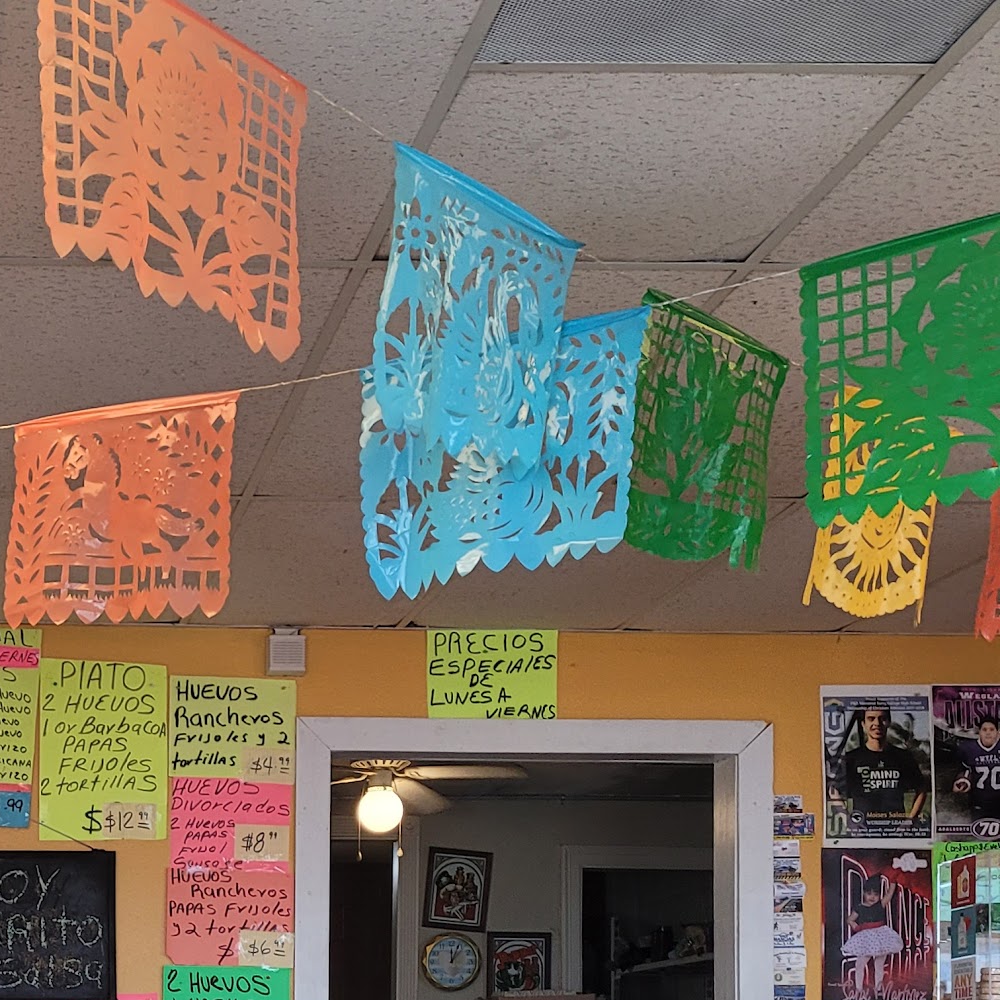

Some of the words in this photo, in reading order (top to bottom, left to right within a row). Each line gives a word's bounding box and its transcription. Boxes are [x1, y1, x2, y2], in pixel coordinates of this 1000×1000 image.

[435, 632, 544, 656] PRECIOS
[430, 655, 556, 678] ESPECIALES
[60, 661, 146, 691] PLATO
[469, 674, 493, 688] DE
[177, 680, 258, 701] HUEVOS
[430, 689, 493, 705] LUNES
[498, 687, 511, 703] A
[42, 694, 55, 711] 2
[65, 694, 155, 714] HUEVOS
[486, 704, 555, 719] VIERNES
[175, 706, 284, 727] Rancheros
[63, 736, 127, 753] PAPAS
[174, 731, 247, 747] Frijoles
[172, 751, 236, 770] tortillas
[870, 771, 900, 779] MIND
[41, 778, 51, 796] 2
[172, 779, 260, 796] HUEVOS
[870, 780, 899, 789] SPIRIT
[979, 822, 1000, 836] 70
[184, 831, 227, 845] PAPAS
[171, 868, 232, 884] HUEVOS
[191, 883, 287, 899] Rancheros
[169, 901, 216, 917] PAPAS
[225, 902, 290, 917] Frijoles
[167, 969, 181, 993] 2
[190, 972, 270, 996] HUEVOS
[955, 973, 972, 987] ANY
[954, 987, 973, 999] TIME
